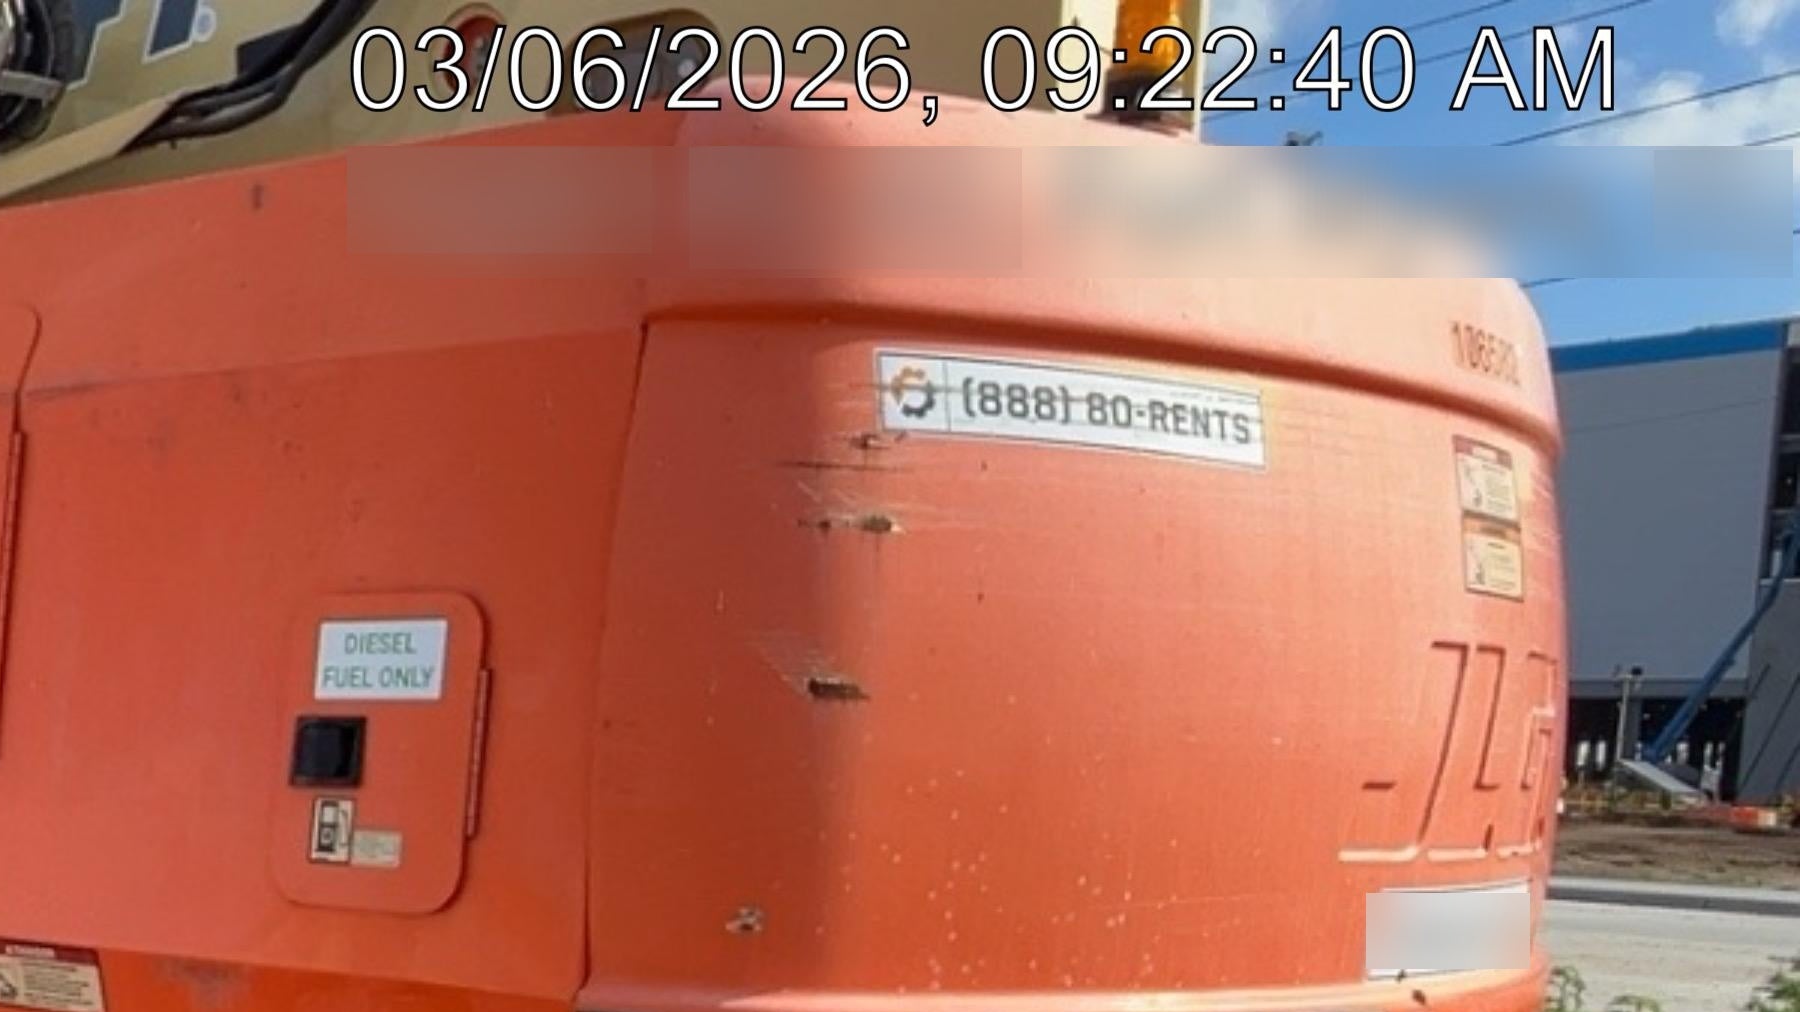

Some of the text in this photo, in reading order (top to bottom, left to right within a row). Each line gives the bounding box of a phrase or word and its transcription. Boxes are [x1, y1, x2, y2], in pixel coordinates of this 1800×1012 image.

[962, 376, 1252, 446] (888) 80-RENTS
[343, 632, 417, 655] DIESEL
[322, 664, 436, 689] FUEL ONLY
